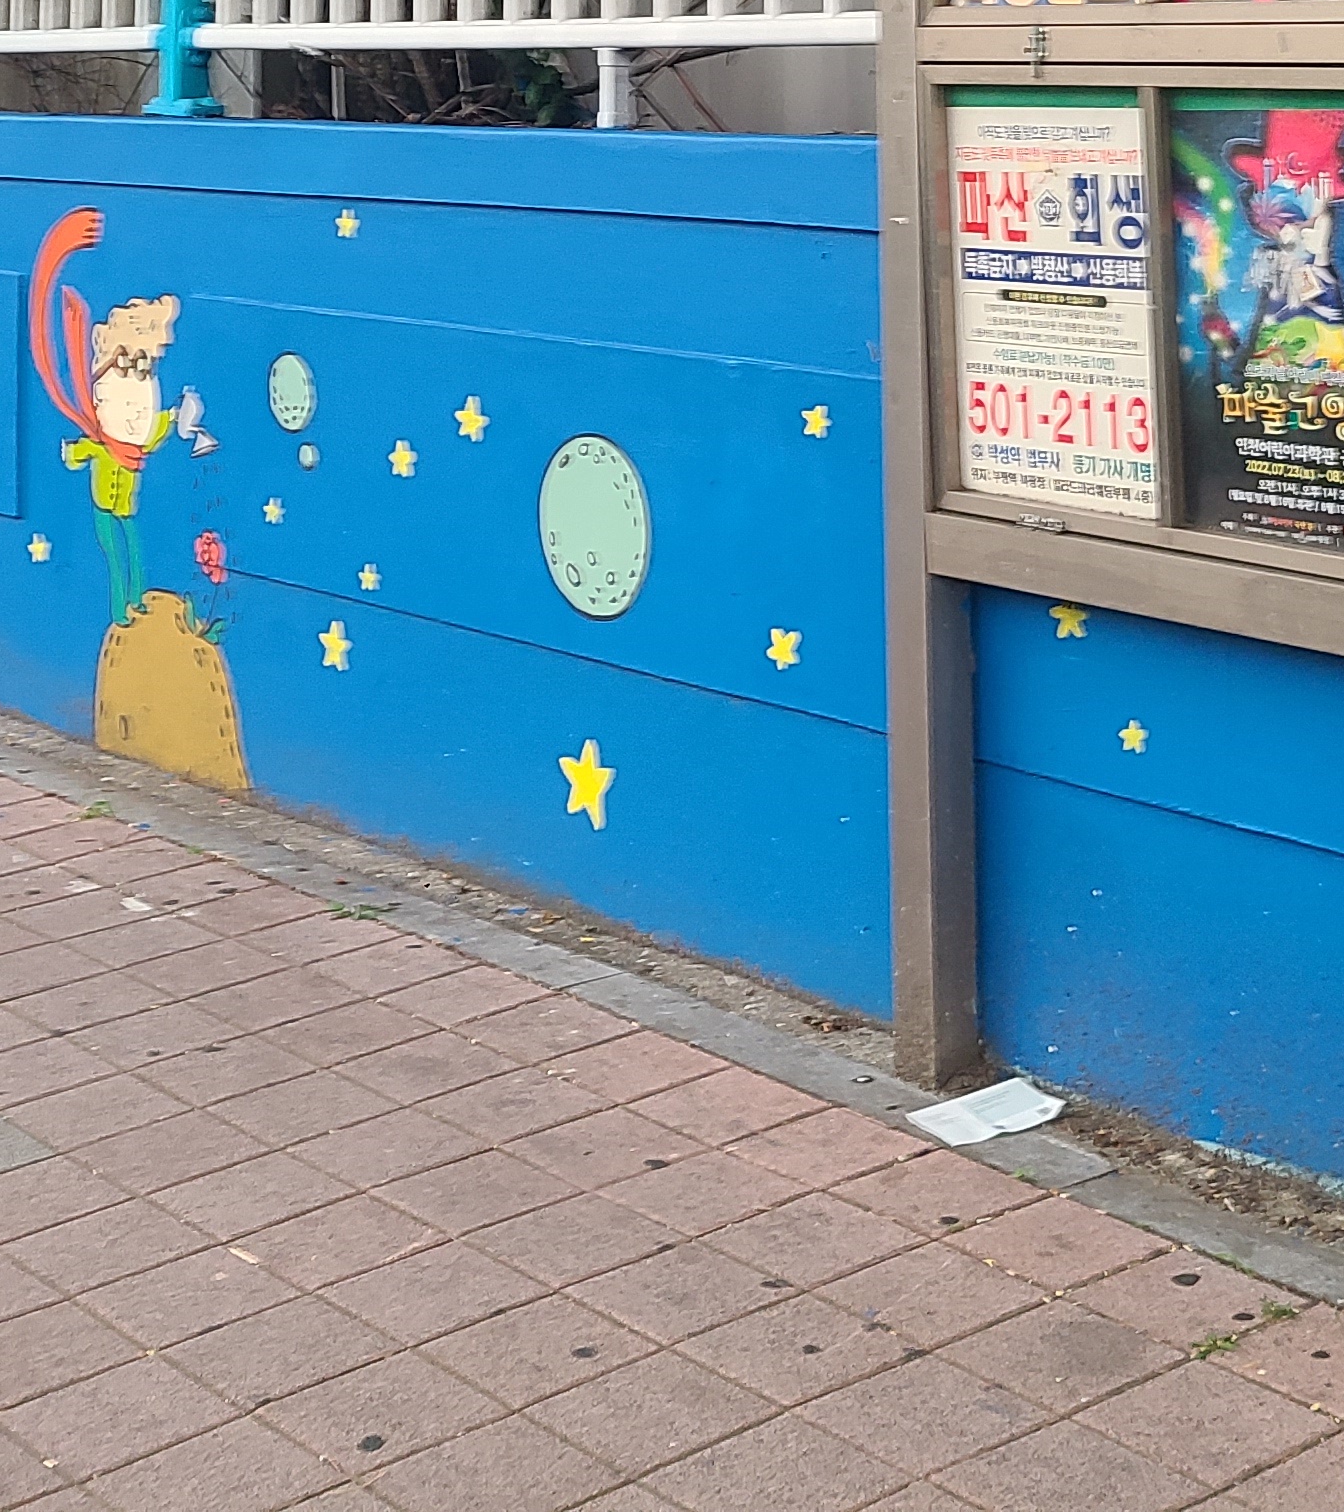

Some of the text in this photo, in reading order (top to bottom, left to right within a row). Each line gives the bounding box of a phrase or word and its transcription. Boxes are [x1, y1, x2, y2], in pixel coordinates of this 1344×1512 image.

[957, 171, 1149, 251] 파산 회생
[1030, 254, 1074, 283] 빚청산
[1087, 257, 1147, 288] 신용회복
[968, 380, 1151, 454] 501-2113
[1026, 448, 1062, 473] 법무사
[1072, 454, 1097, 477] 등기
[1100, 457, 1125, 480] 가사
[1127, 460, 1153, 484] 개명
[1234, 437, 1341, 467] 인천어린이과학관
